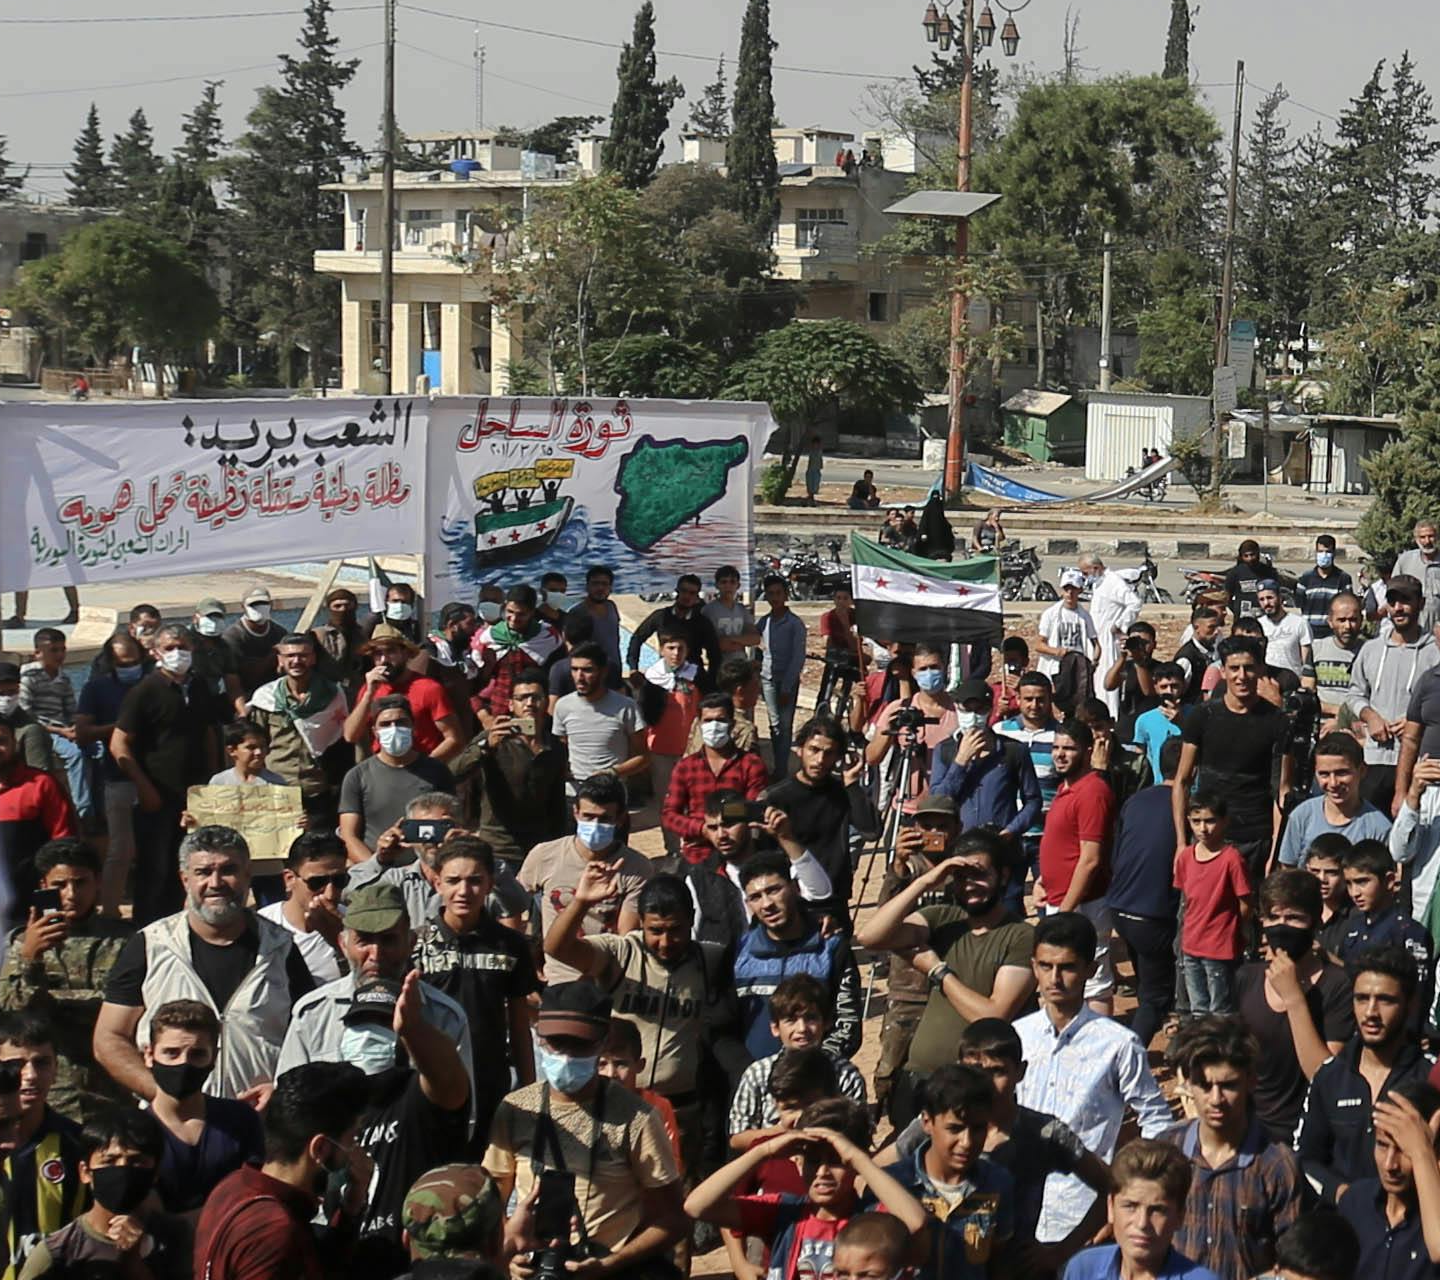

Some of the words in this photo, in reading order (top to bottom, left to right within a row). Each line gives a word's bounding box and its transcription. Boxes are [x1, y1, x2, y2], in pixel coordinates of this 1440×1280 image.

[303, 398, 414, 467] الشعب
[456, 398, 568, 452] الساحل
[560, 399, 634, 460] ثورة
